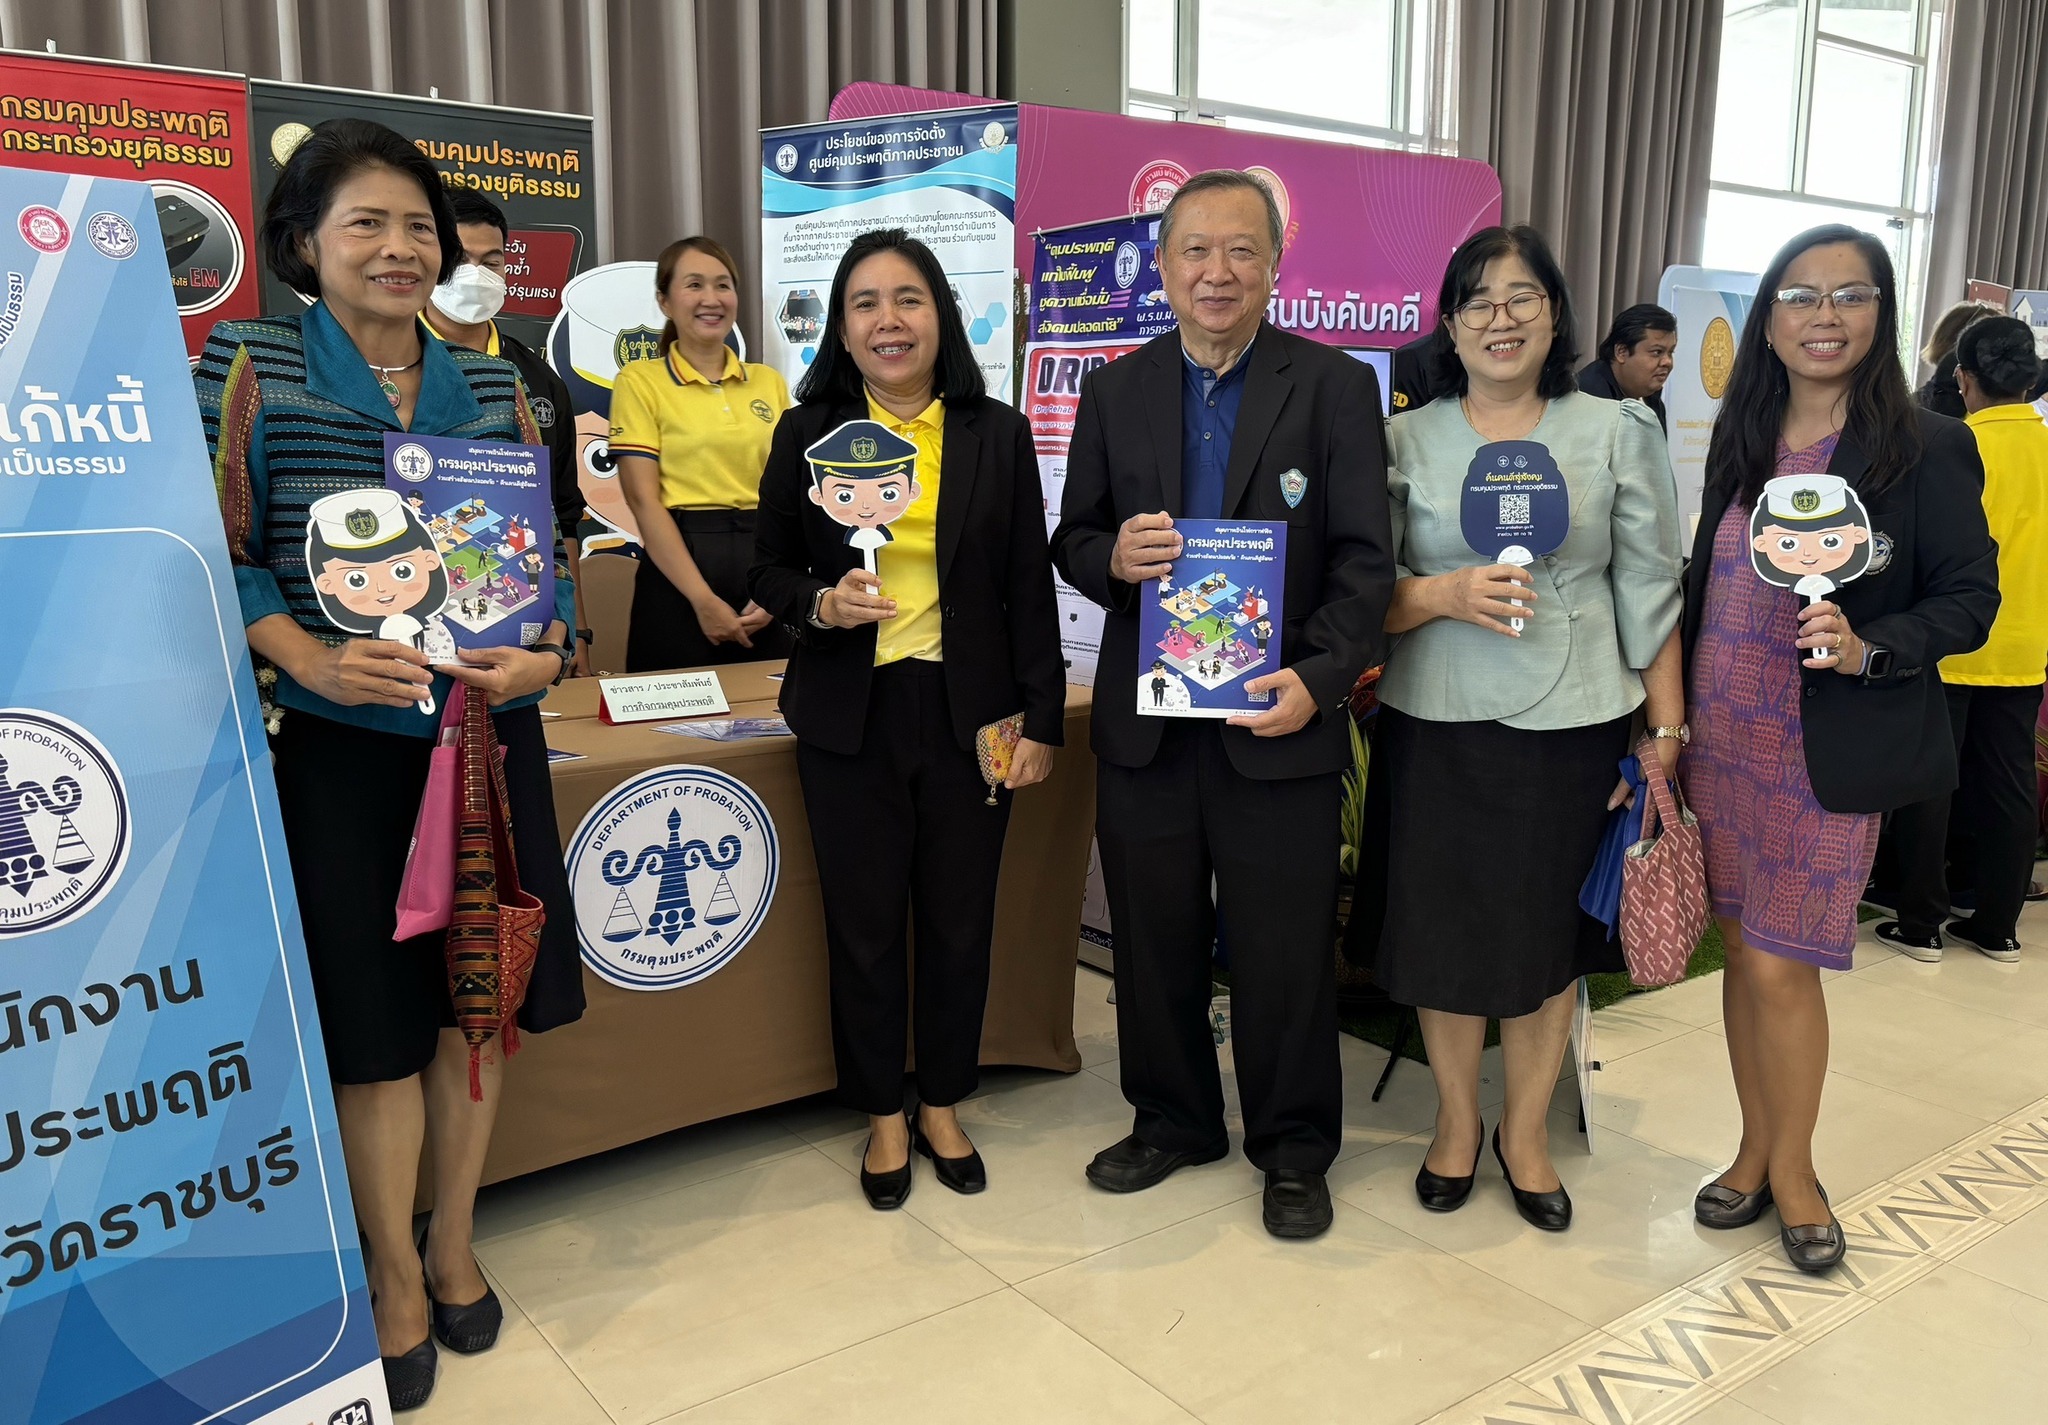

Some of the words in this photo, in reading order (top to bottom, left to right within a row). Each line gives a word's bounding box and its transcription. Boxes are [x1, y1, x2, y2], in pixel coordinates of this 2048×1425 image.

[1, 95, 230, 141] กรมคุมประพฤติ
[2, 129, 232, 169] กระทรวงยุติธรรม
[826, 121, 946, 151] ประโยชน์ของการจัดตั้ง
[808, 144, 964, 174] ศูนย์คุมประพฤติภาคประชาชน
[190, 267, 220, 288] EM
[0, 447, 126, 476] เป็นธรรม
[437, 457, 537, 478] กรมคุมประพฤติ
[1187, 537, 1274, 552] กรมคุมประพฤติ
[610, 680, 645, 695] ข่าวสาร
[653, 677, 713, 691] ประชาสัมพันธ์
[621, 695, 715, 713] ภารกิจกรมคุมประพฤติ
[13, 728, 87, 772] PROBATION
[592, 787, 670, 852] DEPARTMENT
[673, 785, 691, 797] OF
[694, 786, 753, 832] PROBATION
[620, 929, 724, 969] กรมคุมประพฤติ
[0, 1125, 300, 1294] วัดราชบุรี
